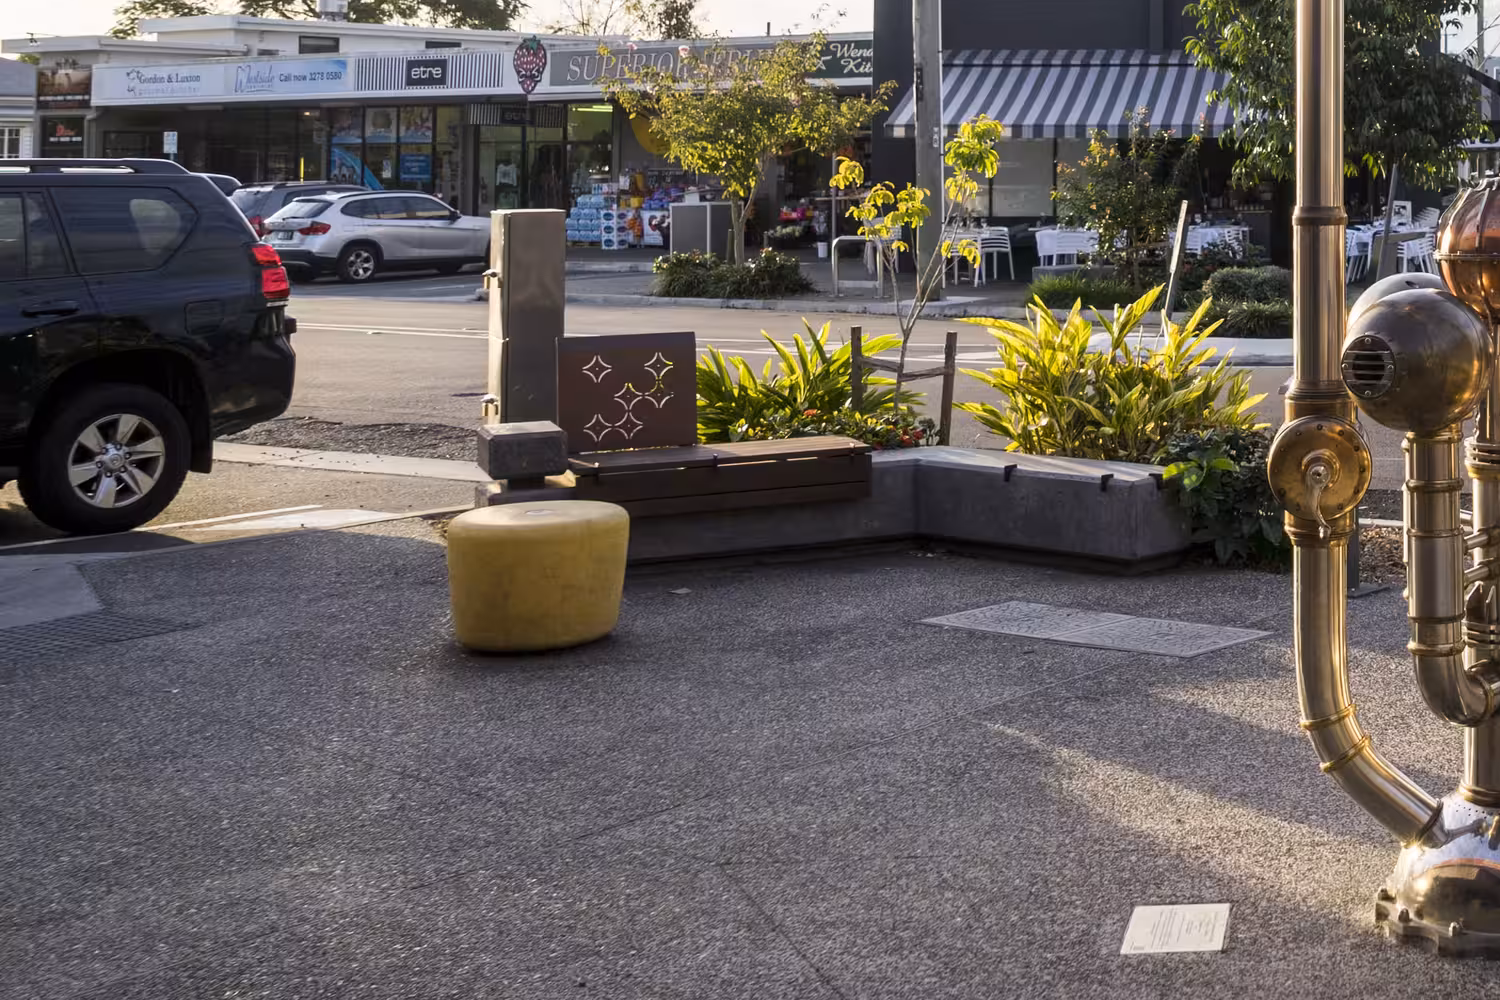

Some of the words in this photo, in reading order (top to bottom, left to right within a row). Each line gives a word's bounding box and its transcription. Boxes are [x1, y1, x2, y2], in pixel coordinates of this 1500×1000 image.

[279, 73, 292, 82] Call
[293, 74, 308, 82] now
[411, 66, 442, 79] etre
